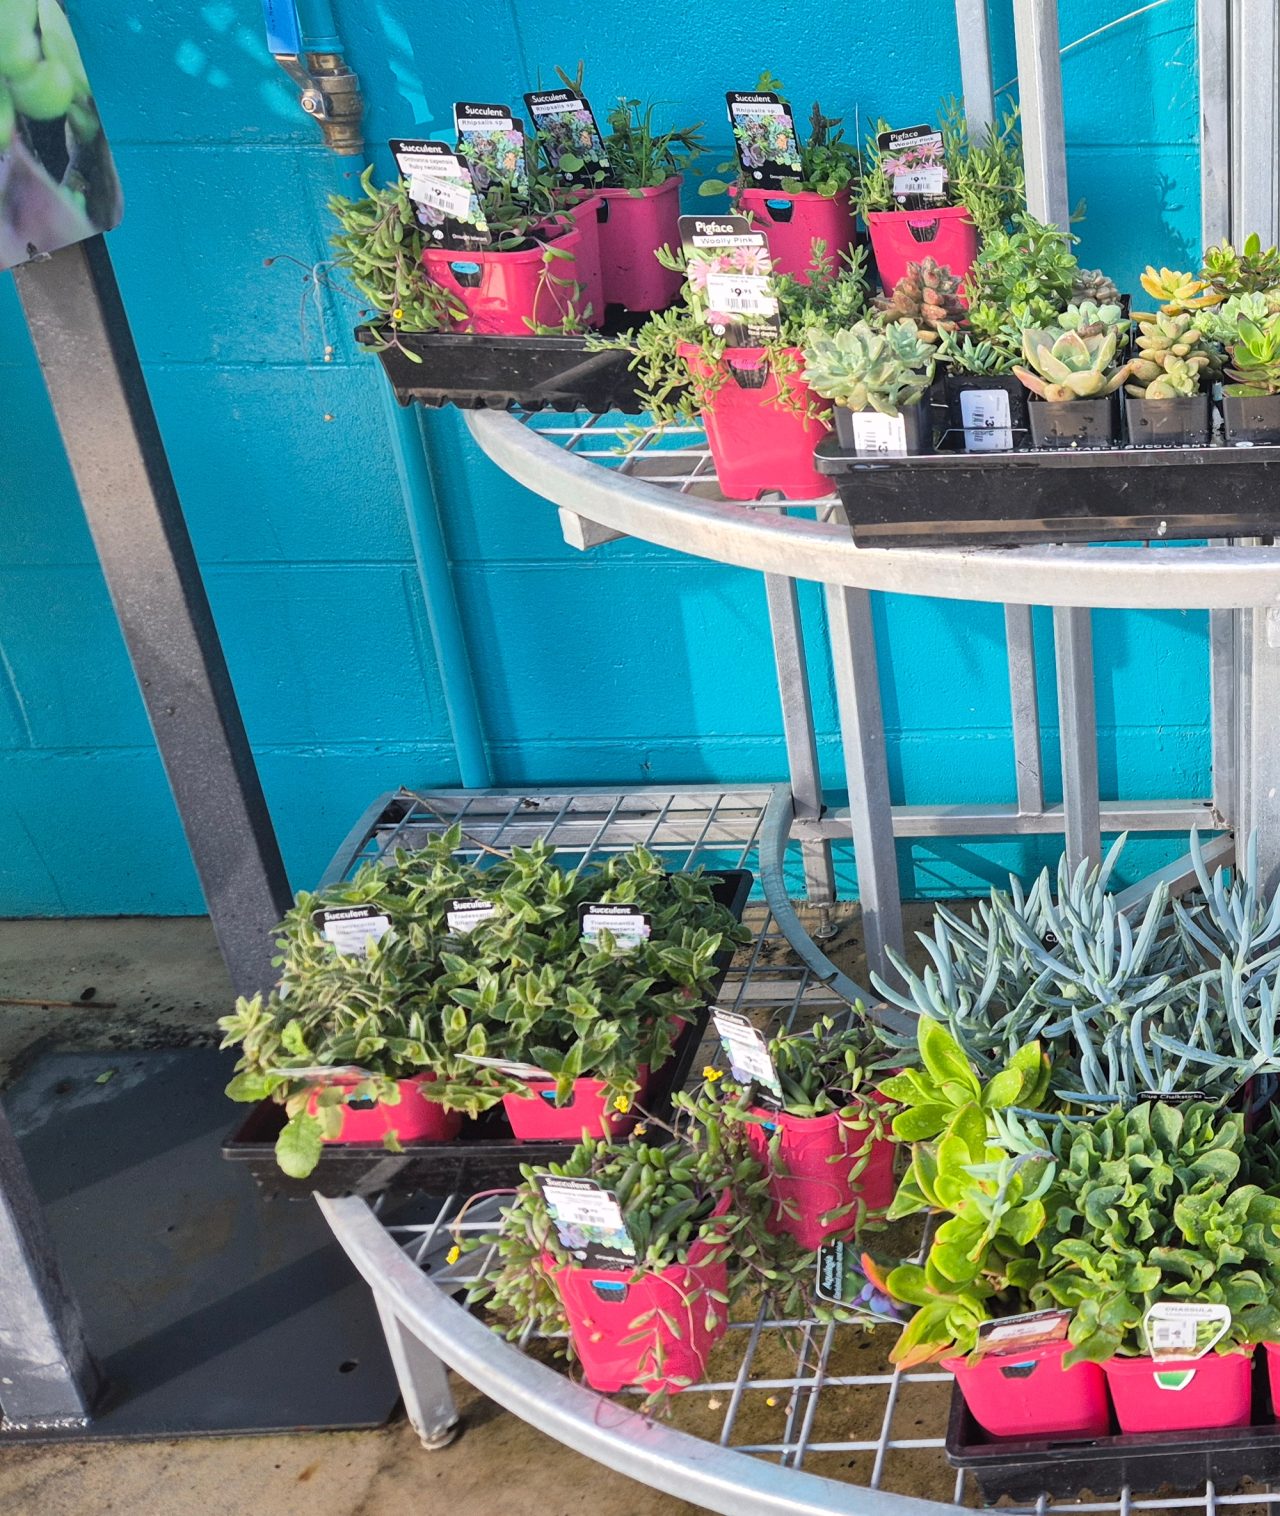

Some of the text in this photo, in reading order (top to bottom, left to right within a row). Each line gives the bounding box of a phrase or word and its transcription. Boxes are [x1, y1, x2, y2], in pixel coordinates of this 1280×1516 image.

[532, 93, 567, 103] Succulent
[735, 94, 771, 102] Succulent
[465, 105, 503, 117] Succulent
[891, 131, 918, 141] Pigface
[400, 143, 443, 153] Succulent
[894, 139, 917, 147] Woolly
[695, 221, 733, 235] Pigface
[701, 237, 731, 245] Woolly
[453, 900, 491, 910] Succulent
[590, 906, 631, 914] Succulent
[324, 910, 368, 920] Succulent
[545, 1178, 591, 1190] Succulent
